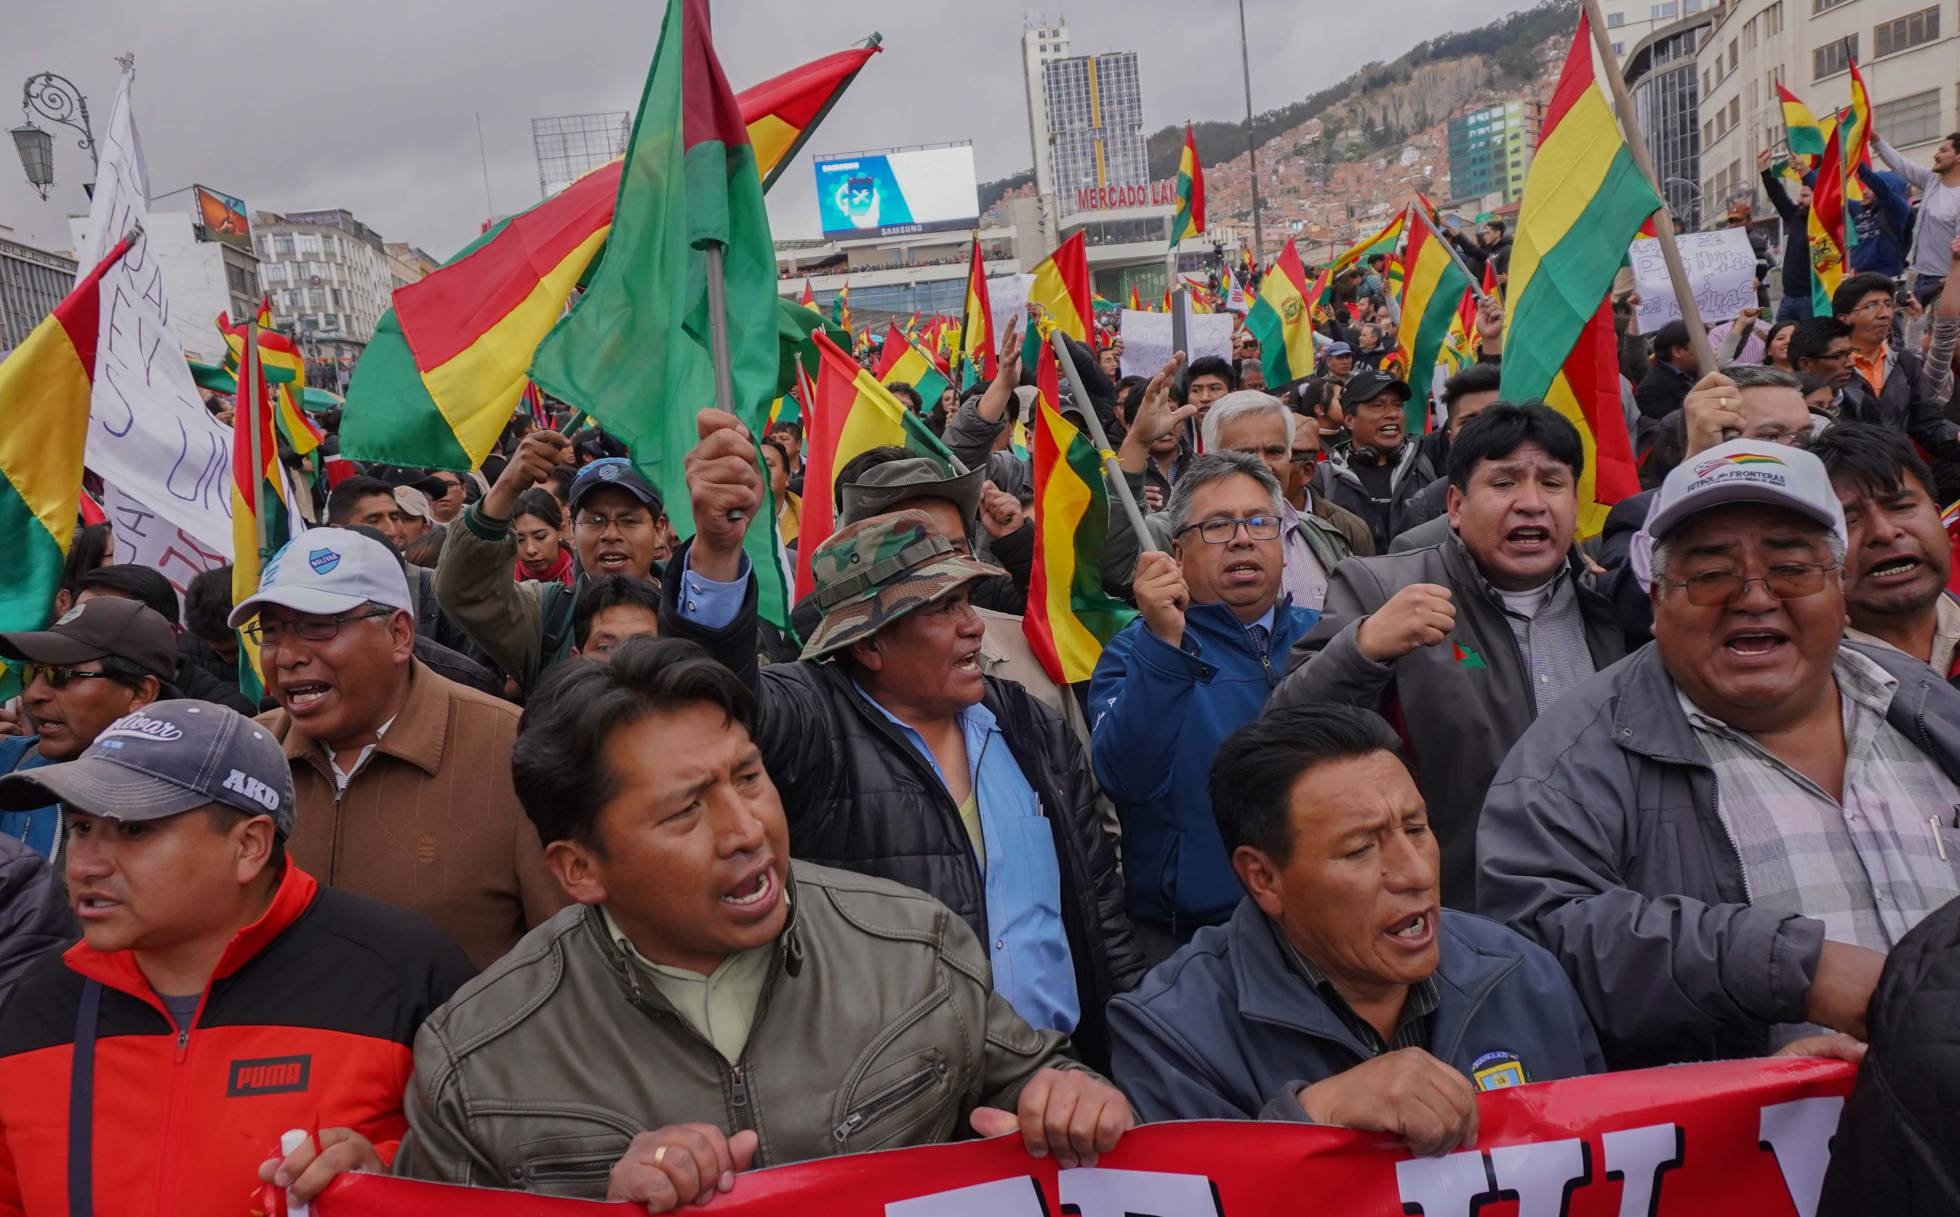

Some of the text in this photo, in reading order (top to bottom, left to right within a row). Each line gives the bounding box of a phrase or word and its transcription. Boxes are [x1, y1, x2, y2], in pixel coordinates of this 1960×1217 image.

[1078, 182, 1178, 209] MERCADO LAN
[880, 224, 923, 236] SAMSUNG
[1669, 279, 1757, 319] RDILLAS
[1729, 470, 1786, 484] FRONTERAS
[98, 710, 183, 741] livar
[222, 768, 280, 811] AKD
[236, 1063, 302, 1089] PUMA
